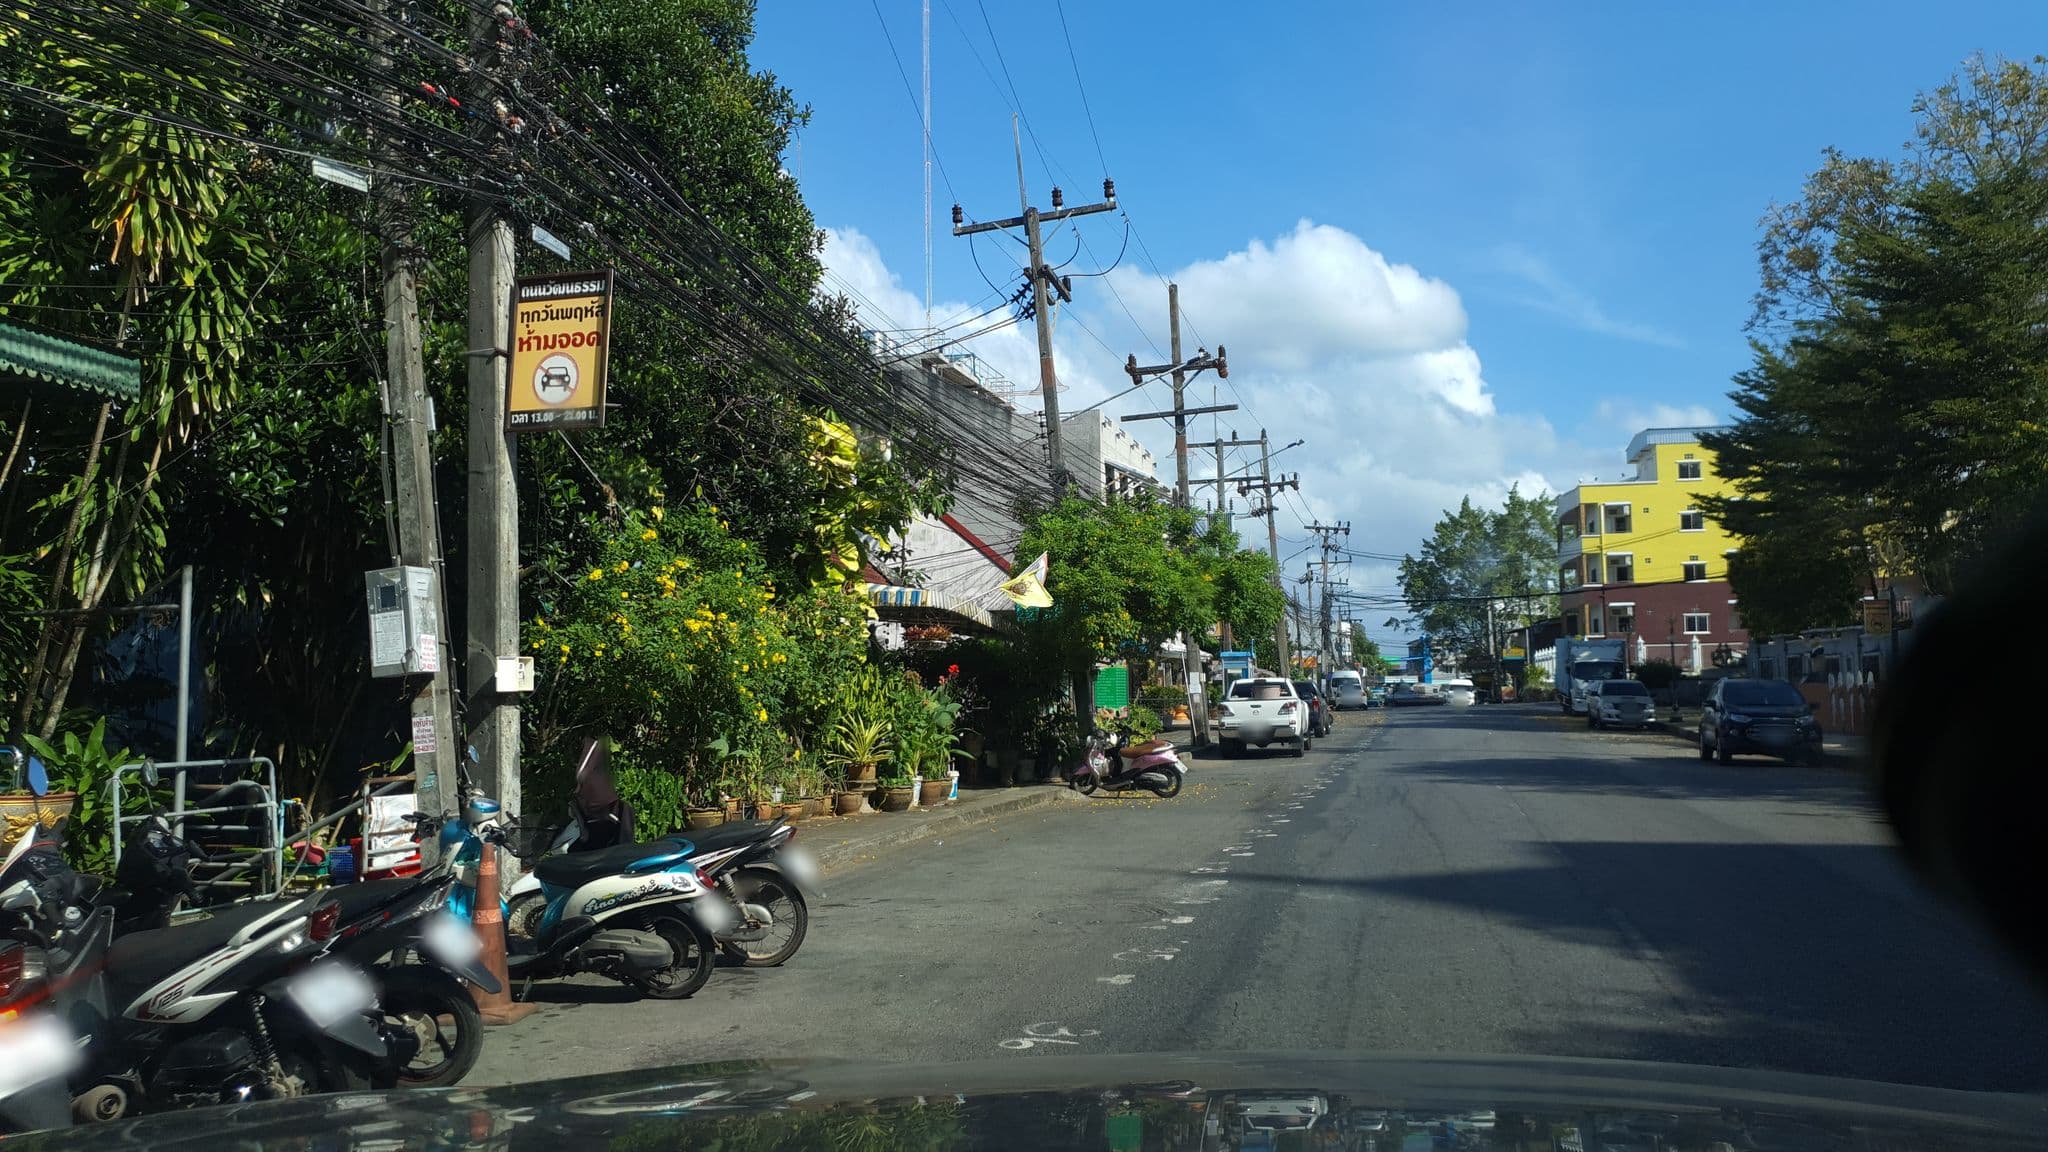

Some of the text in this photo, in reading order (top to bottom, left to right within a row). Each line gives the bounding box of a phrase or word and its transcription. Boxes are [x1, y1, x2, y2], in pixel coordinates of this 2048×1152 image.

[521, 280, 605, 298] ถนนวัฒนธรรม
[520, 300, 605, 328] ทุกวันพฤหัส
[518, 329, 602, 352] ห้ามจอด
[511, 413, 529, 424] เวลา
